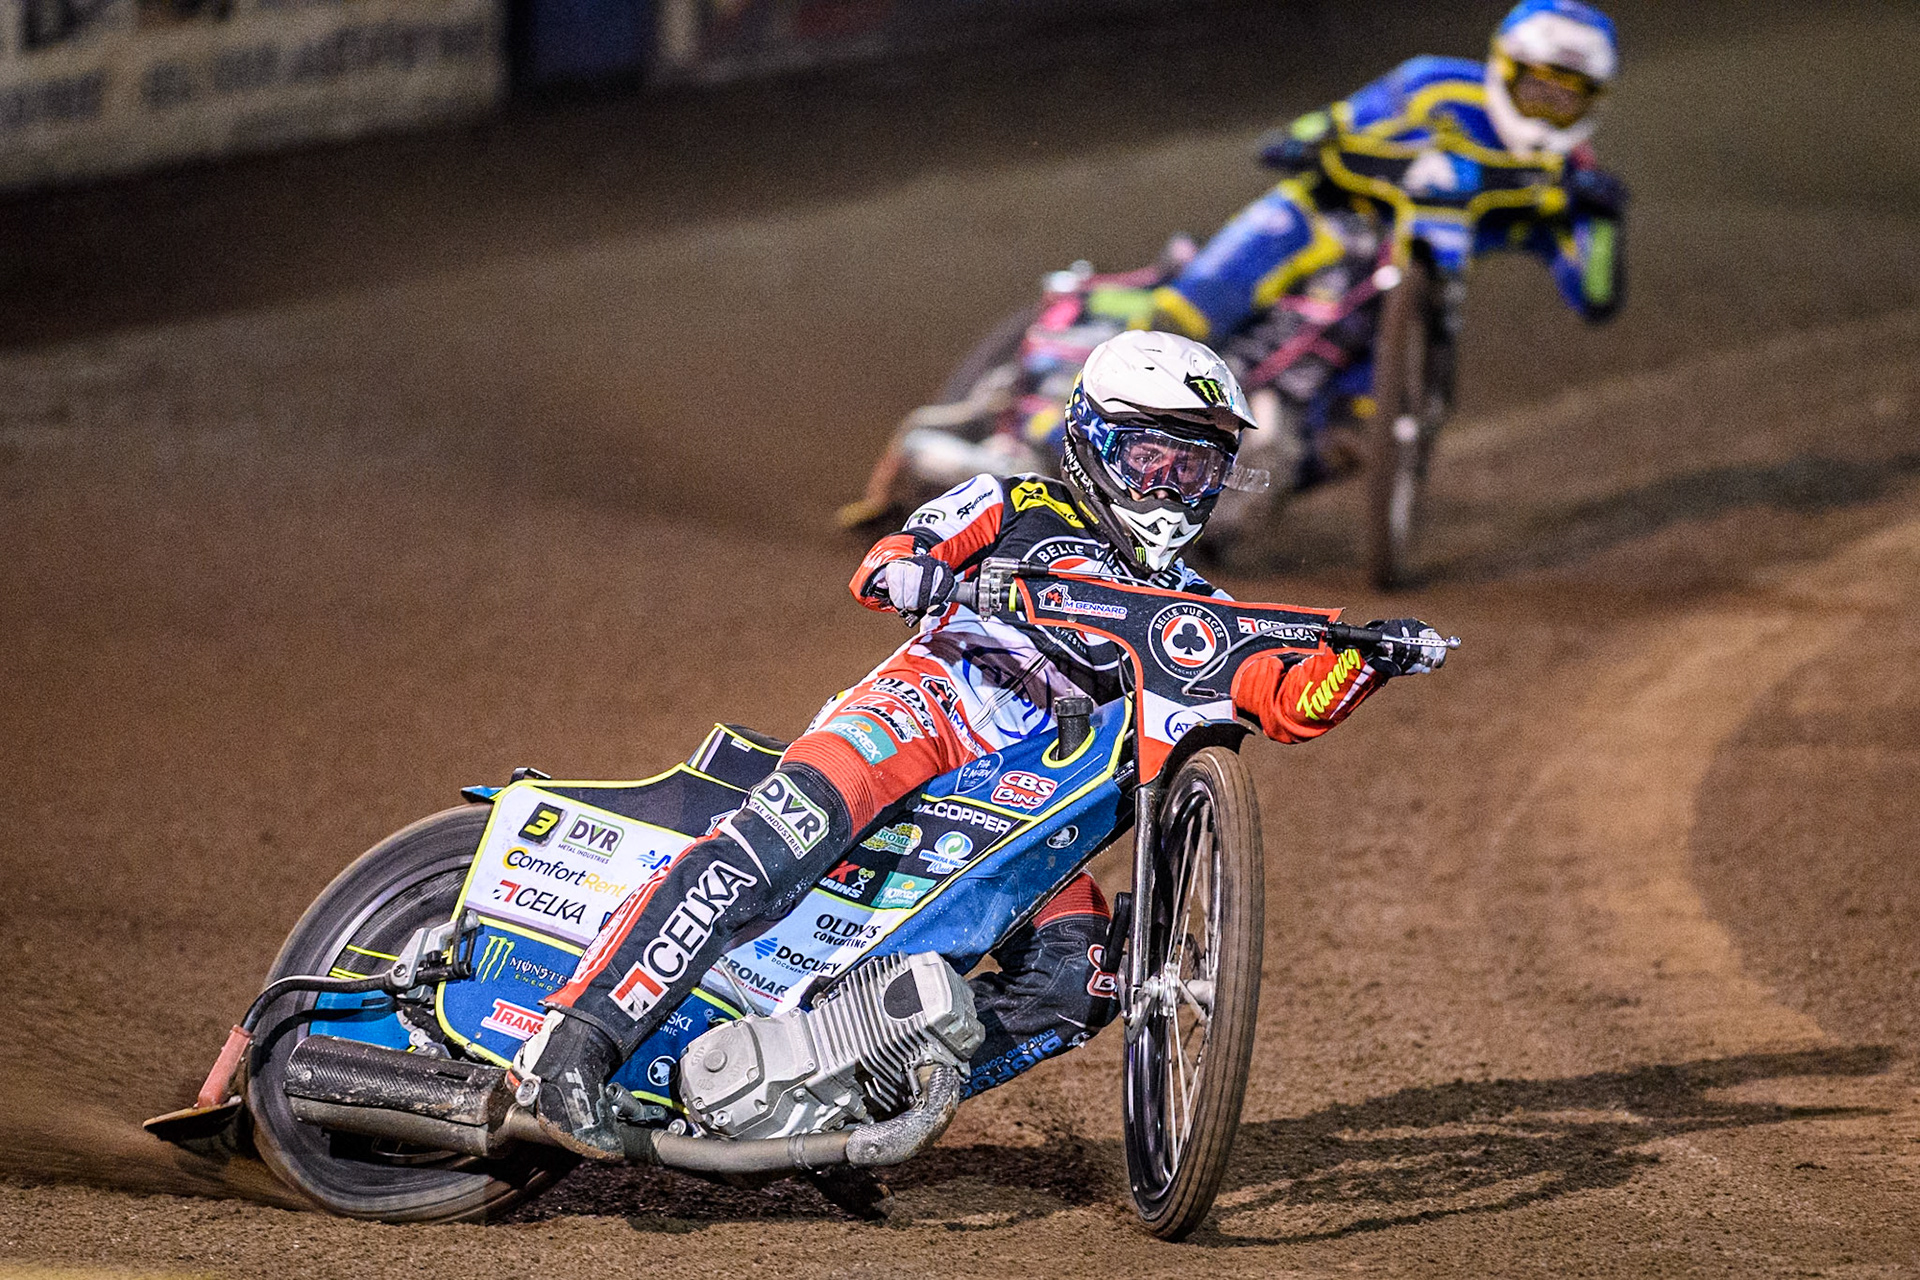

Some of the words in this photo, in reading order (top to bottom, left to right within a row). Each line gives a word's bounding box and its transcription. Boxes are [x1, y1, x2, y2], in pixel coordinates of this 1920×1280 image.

[1037, 543, 1085, 563] BELLE
[1075, 602, 1126, 615] GENNARD
[1154, 606, 1180, 631] BELLE
[1182, 606, 1204, 618] VUE
[1205, 616, 1225, 639] ACES
[873, 686, 929, 727] CONCRETG
[995, 788, 1045, 805] BINS
[1003, 773, 1053, 796] CBS
[523, 809, 560, 837] 3
[759, 778, 822, 842] DVR
[569, 819, 619, 852] DVR
[764, 811, 806, 858] INDUSTRIES
[558, 843, 576, 854] METAL
[577, 849, 610, 865] INDUSTRIES
[515, 887, 587, 925] CELKA
[648, 863, 753, 979] CELKA
[816, 913, 881, 938] OLDY'S
[776, 945, 841, 977] DOCUFY
[514, 973, 560, 992] ENERG
[492, 1001, 544, 1035] TRANS
[1028, 1028, 1057, 1045] CIVIL
